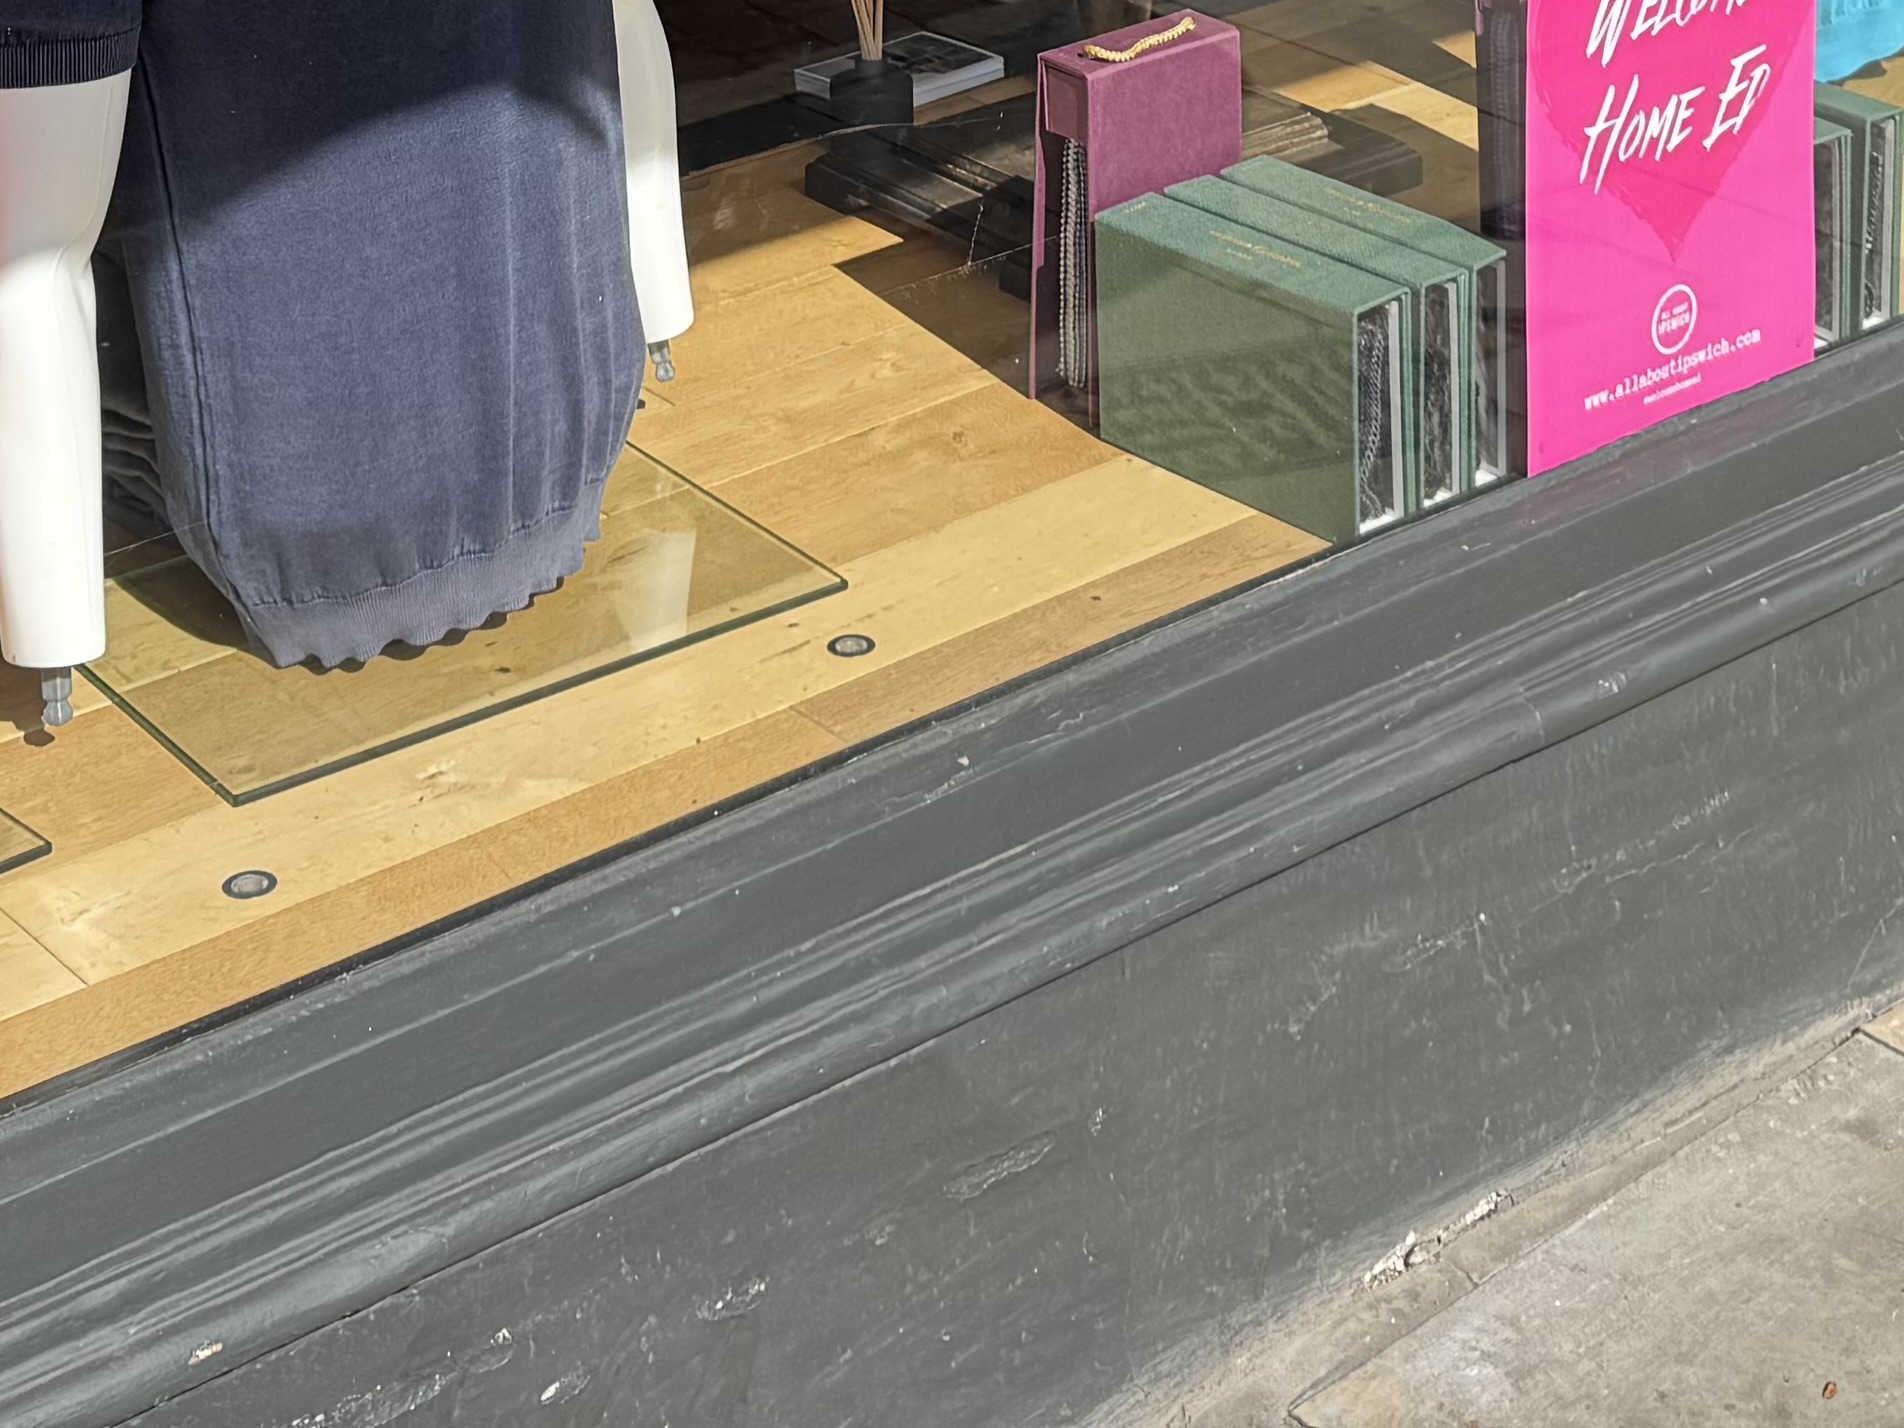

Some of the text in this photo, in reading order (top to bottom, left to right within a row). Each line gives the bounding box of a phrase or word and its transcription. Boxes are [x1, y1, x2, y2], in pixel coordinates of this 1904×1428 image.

[1579, 44, 1771, 195] HOME ED
[1584, 329, 1761, 411] www.allaboutipswich.com
